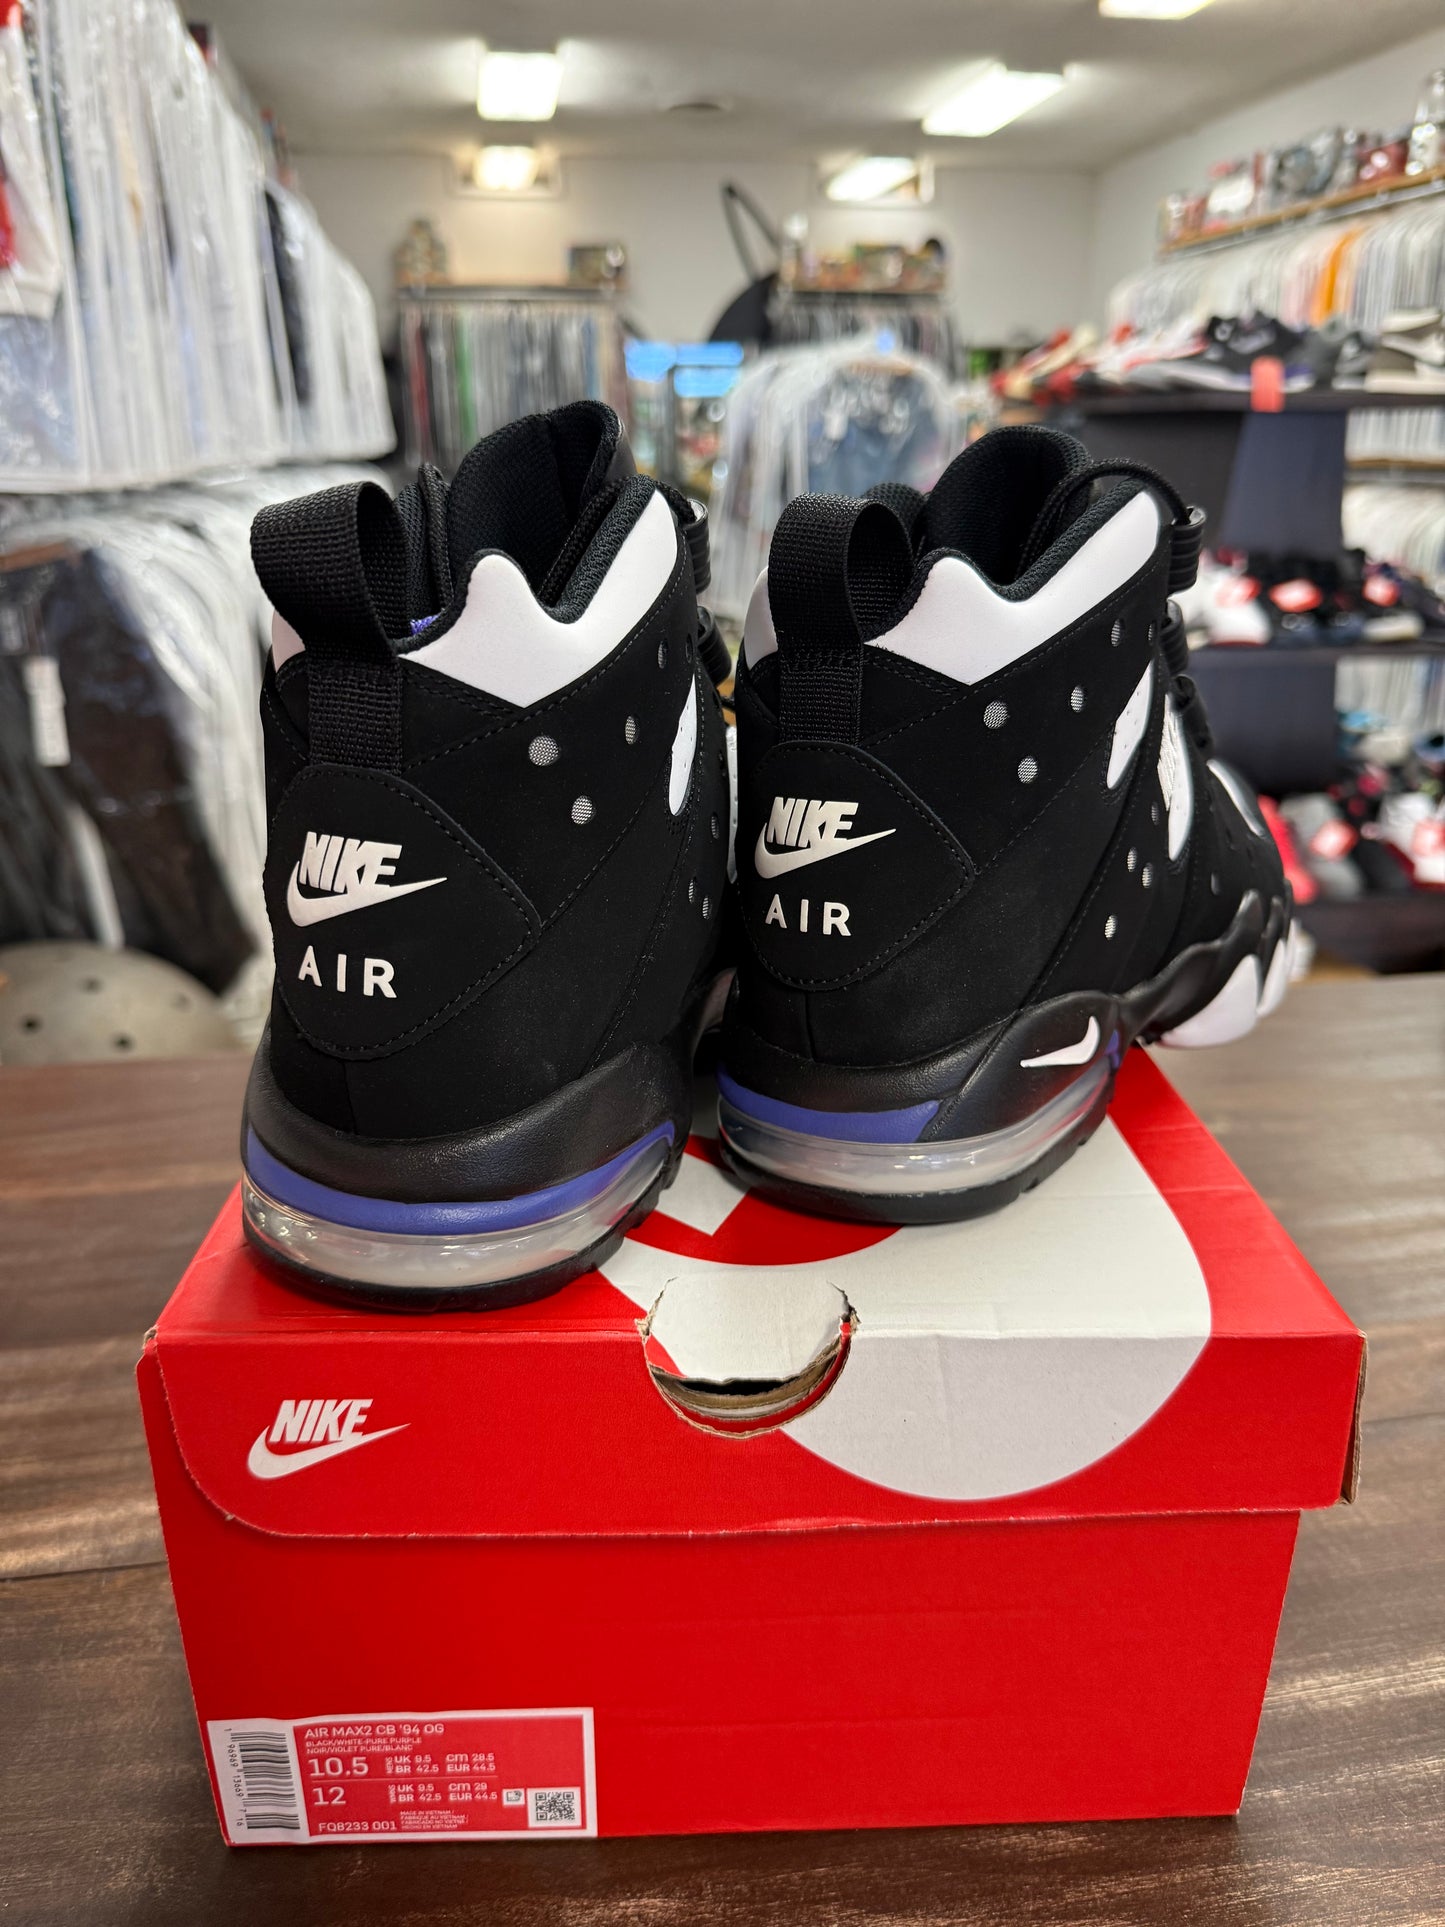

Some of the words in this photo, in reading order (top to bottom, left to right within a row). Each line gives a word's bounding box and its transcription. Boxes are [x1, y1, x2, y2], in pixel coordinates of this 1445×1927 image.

[765, 796, 859, 848] NIKE
[299, 831, 403, 894] NIKE
[765, 893, 852, 937] AIR
[298, 945, 398, 999] AIR
[269, 1399, 374, 1443] NIKE
[304, 1727, 330, 1739] AIR
[331, 1725, 373, 1737] MAX2
[376, 1724, 397, 1735] CB
[400, 1723, 420, 1735] '94
[424, 1723, 445, 1734] OG
[390, 1736, 422, 1745] PURPLE
[227, 1744, 239, 1767] 96969
[394, 1755, 412, 1764] UK
[415, 1754, 432, 1763] 9.5
[446, 1753, 469, 1762] cm
[472, 1752, 495, 1762] 28.5
[307, 1756, 370, 1777] 10.5
[395, 1764, 412, 1773] BR
[416, 1763, 440, 1773] 42.5
[446, 1763, 471, 1772] EUR
[472, 1762, 496, 1772] 44.5
[232, 1775, 244, 1797] 13669
[312, 1785, 347, 1806] 12
[397, 1783, 415, 1793] UK
[418, 1783, 435, 1792] 9.5
[448, 1782, 471, 1792] cm
[473, 1782, 488, 1791] 29
[398, 1793, 415, 1802] BR
[419, 1792, 442, 1802] 42.5
[449, 1792, 473, 1801] EUR
[474, 1791, 498, 1801] 44.5
[236, 1818, 244, 1827] 16
[318, 1821, 370, 1833] FQ8233
[372, 1820, 397, 1831] 001
